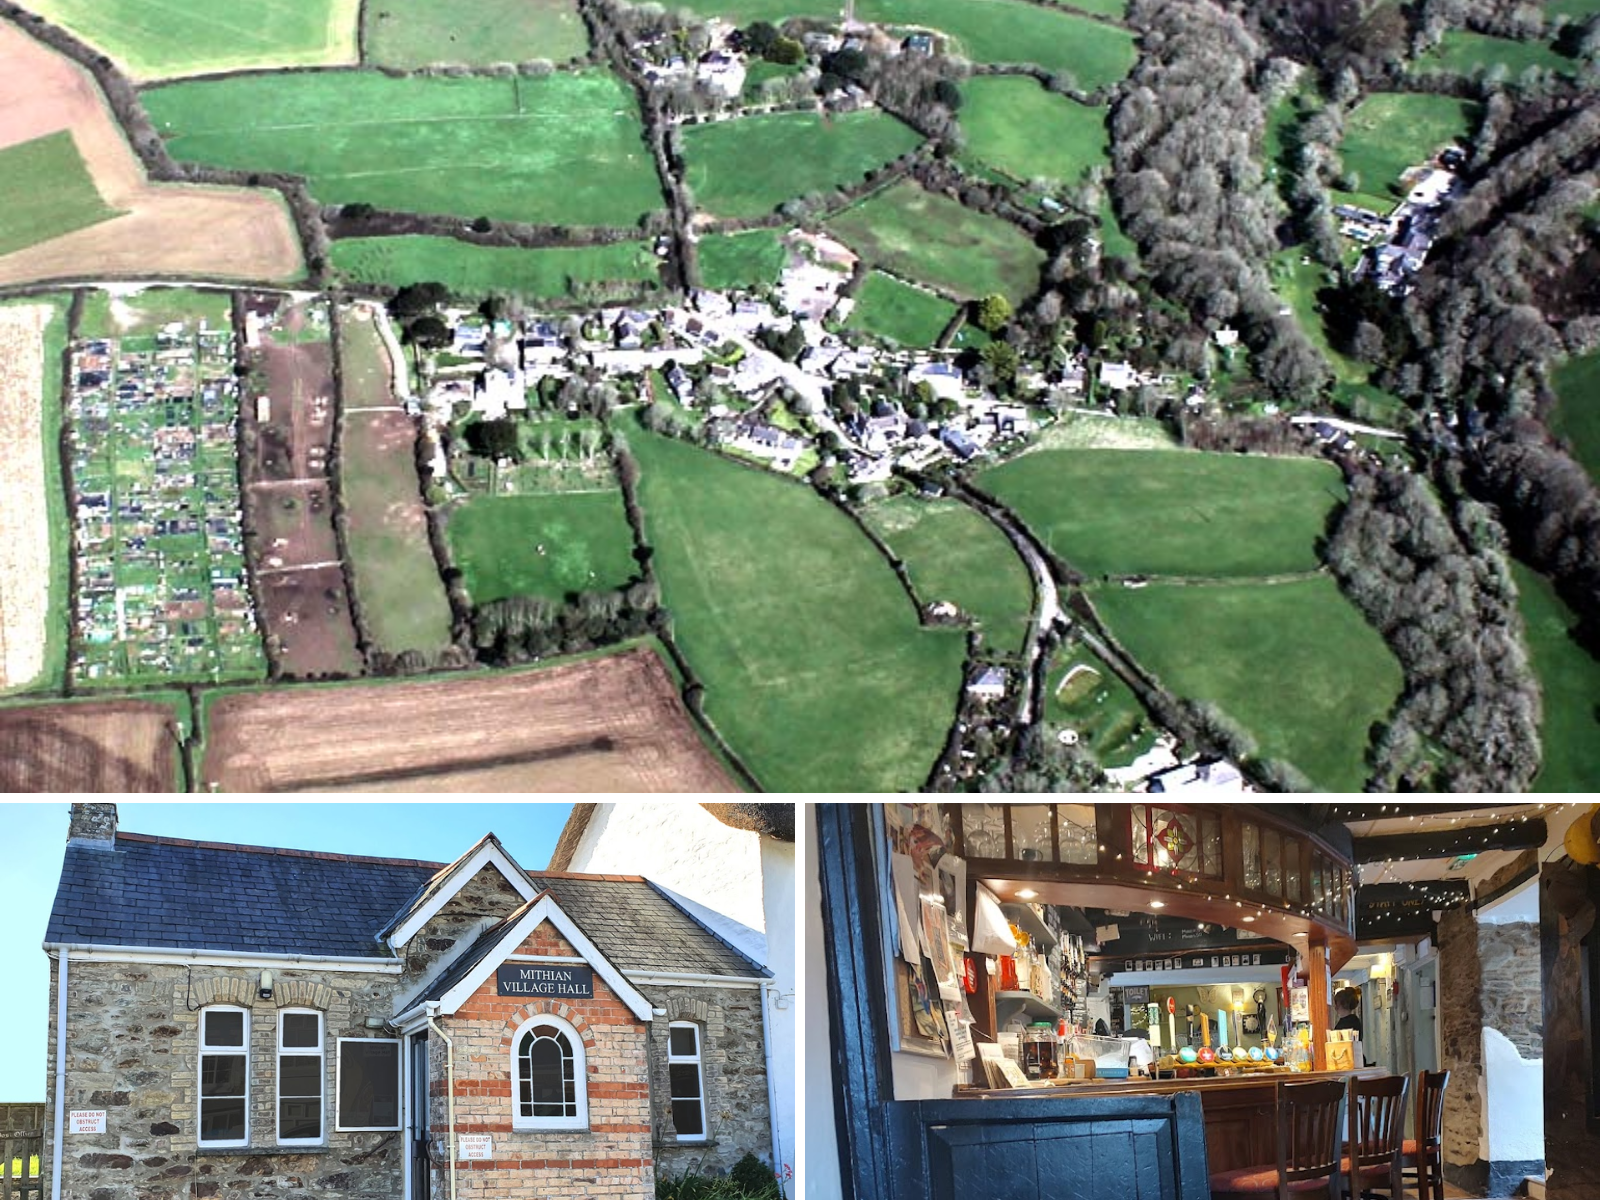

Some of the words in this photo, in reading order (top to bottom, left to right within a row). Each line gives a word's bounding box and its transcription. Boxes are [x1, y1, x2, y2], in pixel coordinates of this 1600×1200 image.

[520, 969, 572, 981] MITHIAN
[503, 981, 555, 993] VILLAGE
[558, 983, 590, 994] HALL
[1125, 987, 1148, 996] TOILET
